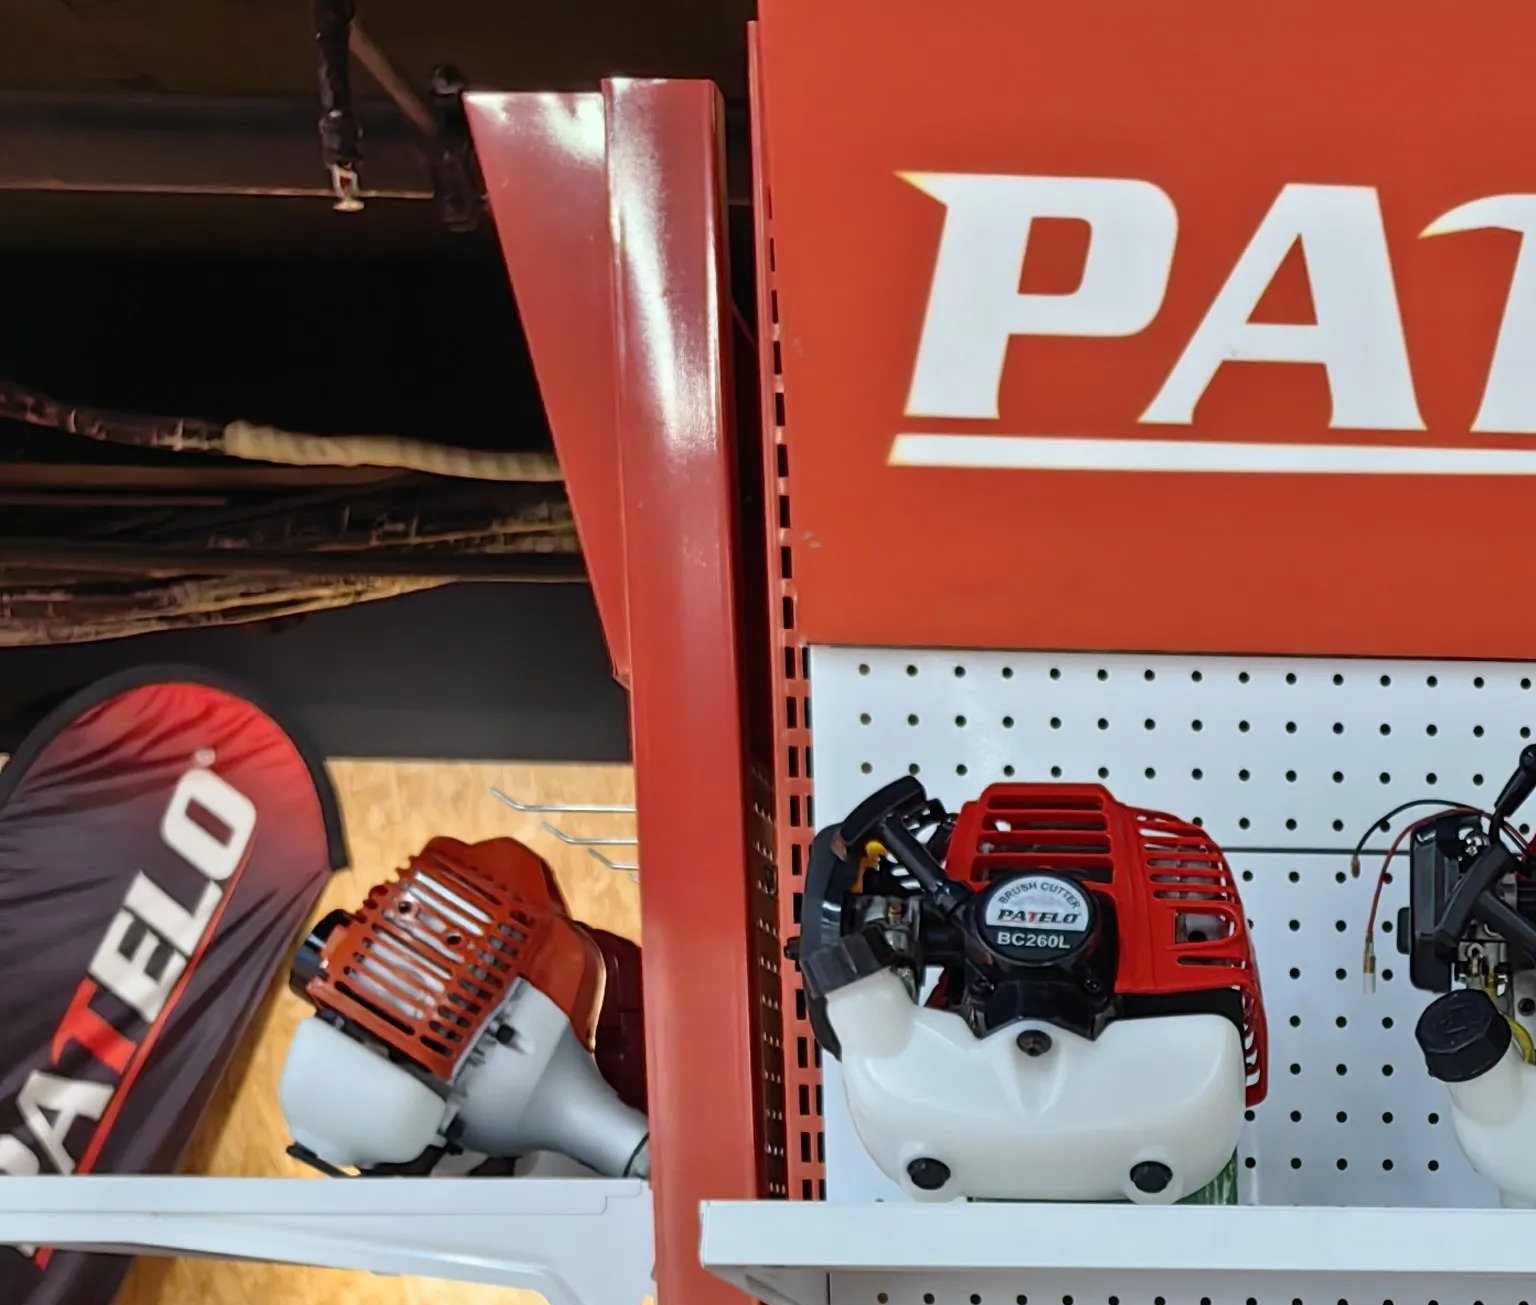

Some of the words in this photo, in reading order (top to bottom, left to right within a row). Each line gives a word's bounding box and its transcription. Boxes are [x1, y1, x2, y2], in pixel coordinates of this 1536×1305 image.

[998, 881, 1037, 904] BRUSH
[1040, 881, 1081, 909] CUTTER
[998, 908, 1080, 923] PATELO
[996, 931, 1071, 949] BC260L
